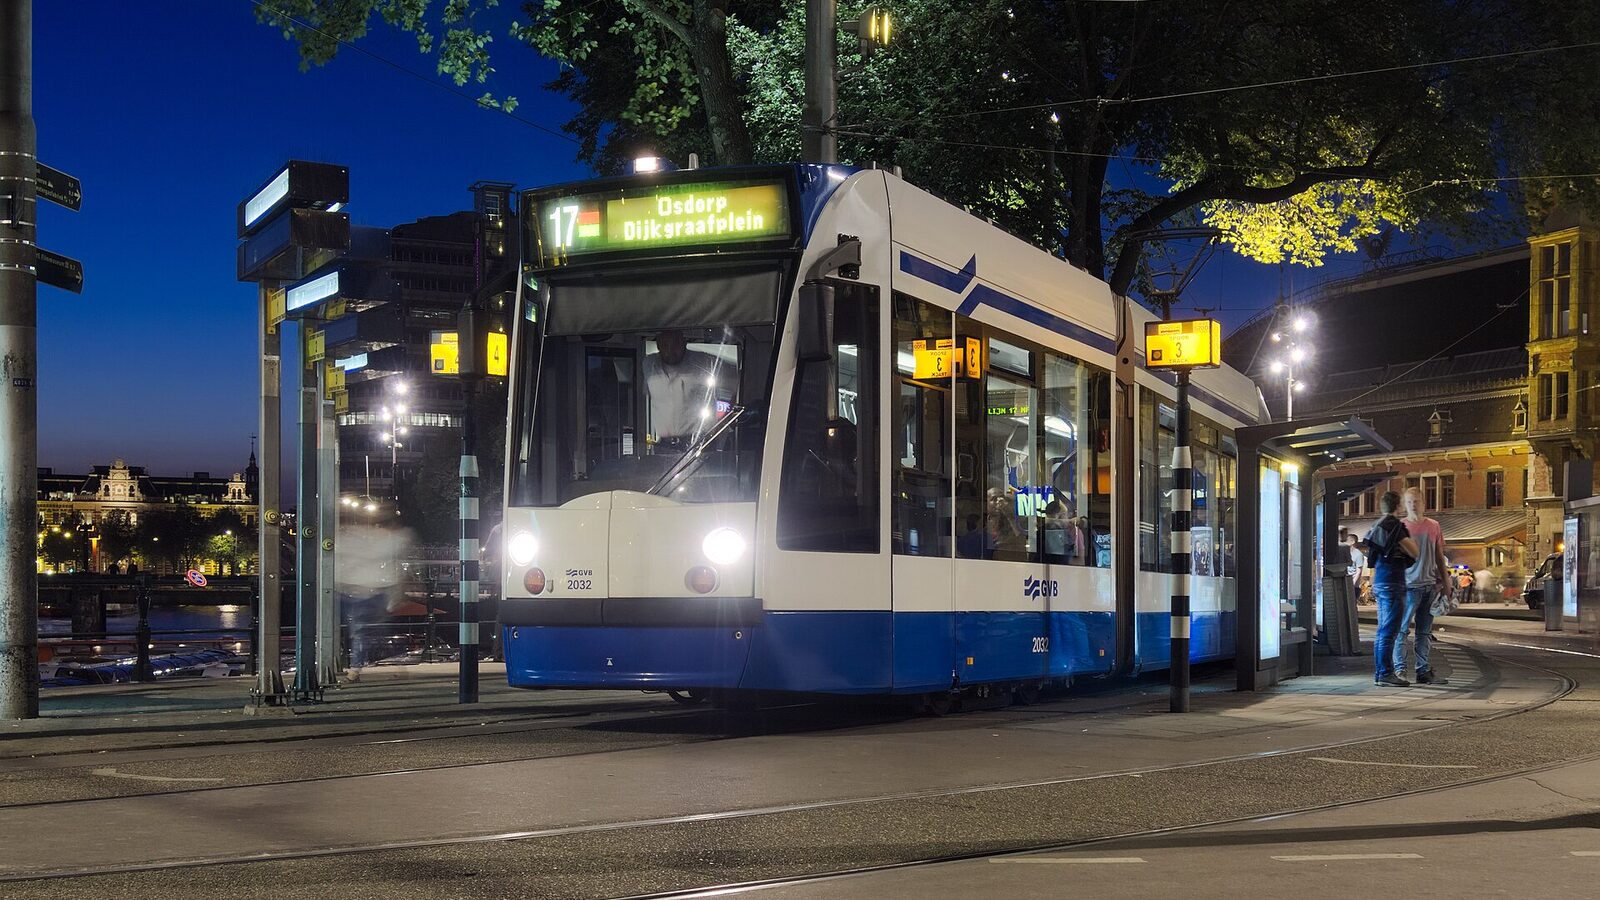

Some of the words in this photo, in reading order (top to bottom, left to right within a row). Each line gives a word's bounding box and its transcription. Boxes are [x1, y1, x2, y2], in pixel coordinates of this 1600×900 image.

[657, 194, 728, 217] Osdorp
[549, 205, 579, 248] 17
[623, 208, 764, 240] Dijkgraafplein
[1175, 342, 1183, 358] 3
[567, 579, 592, 590] 2032
[1041, 579, 1059, 597] GVB
[1032, 637, 1049, 653] 2032
